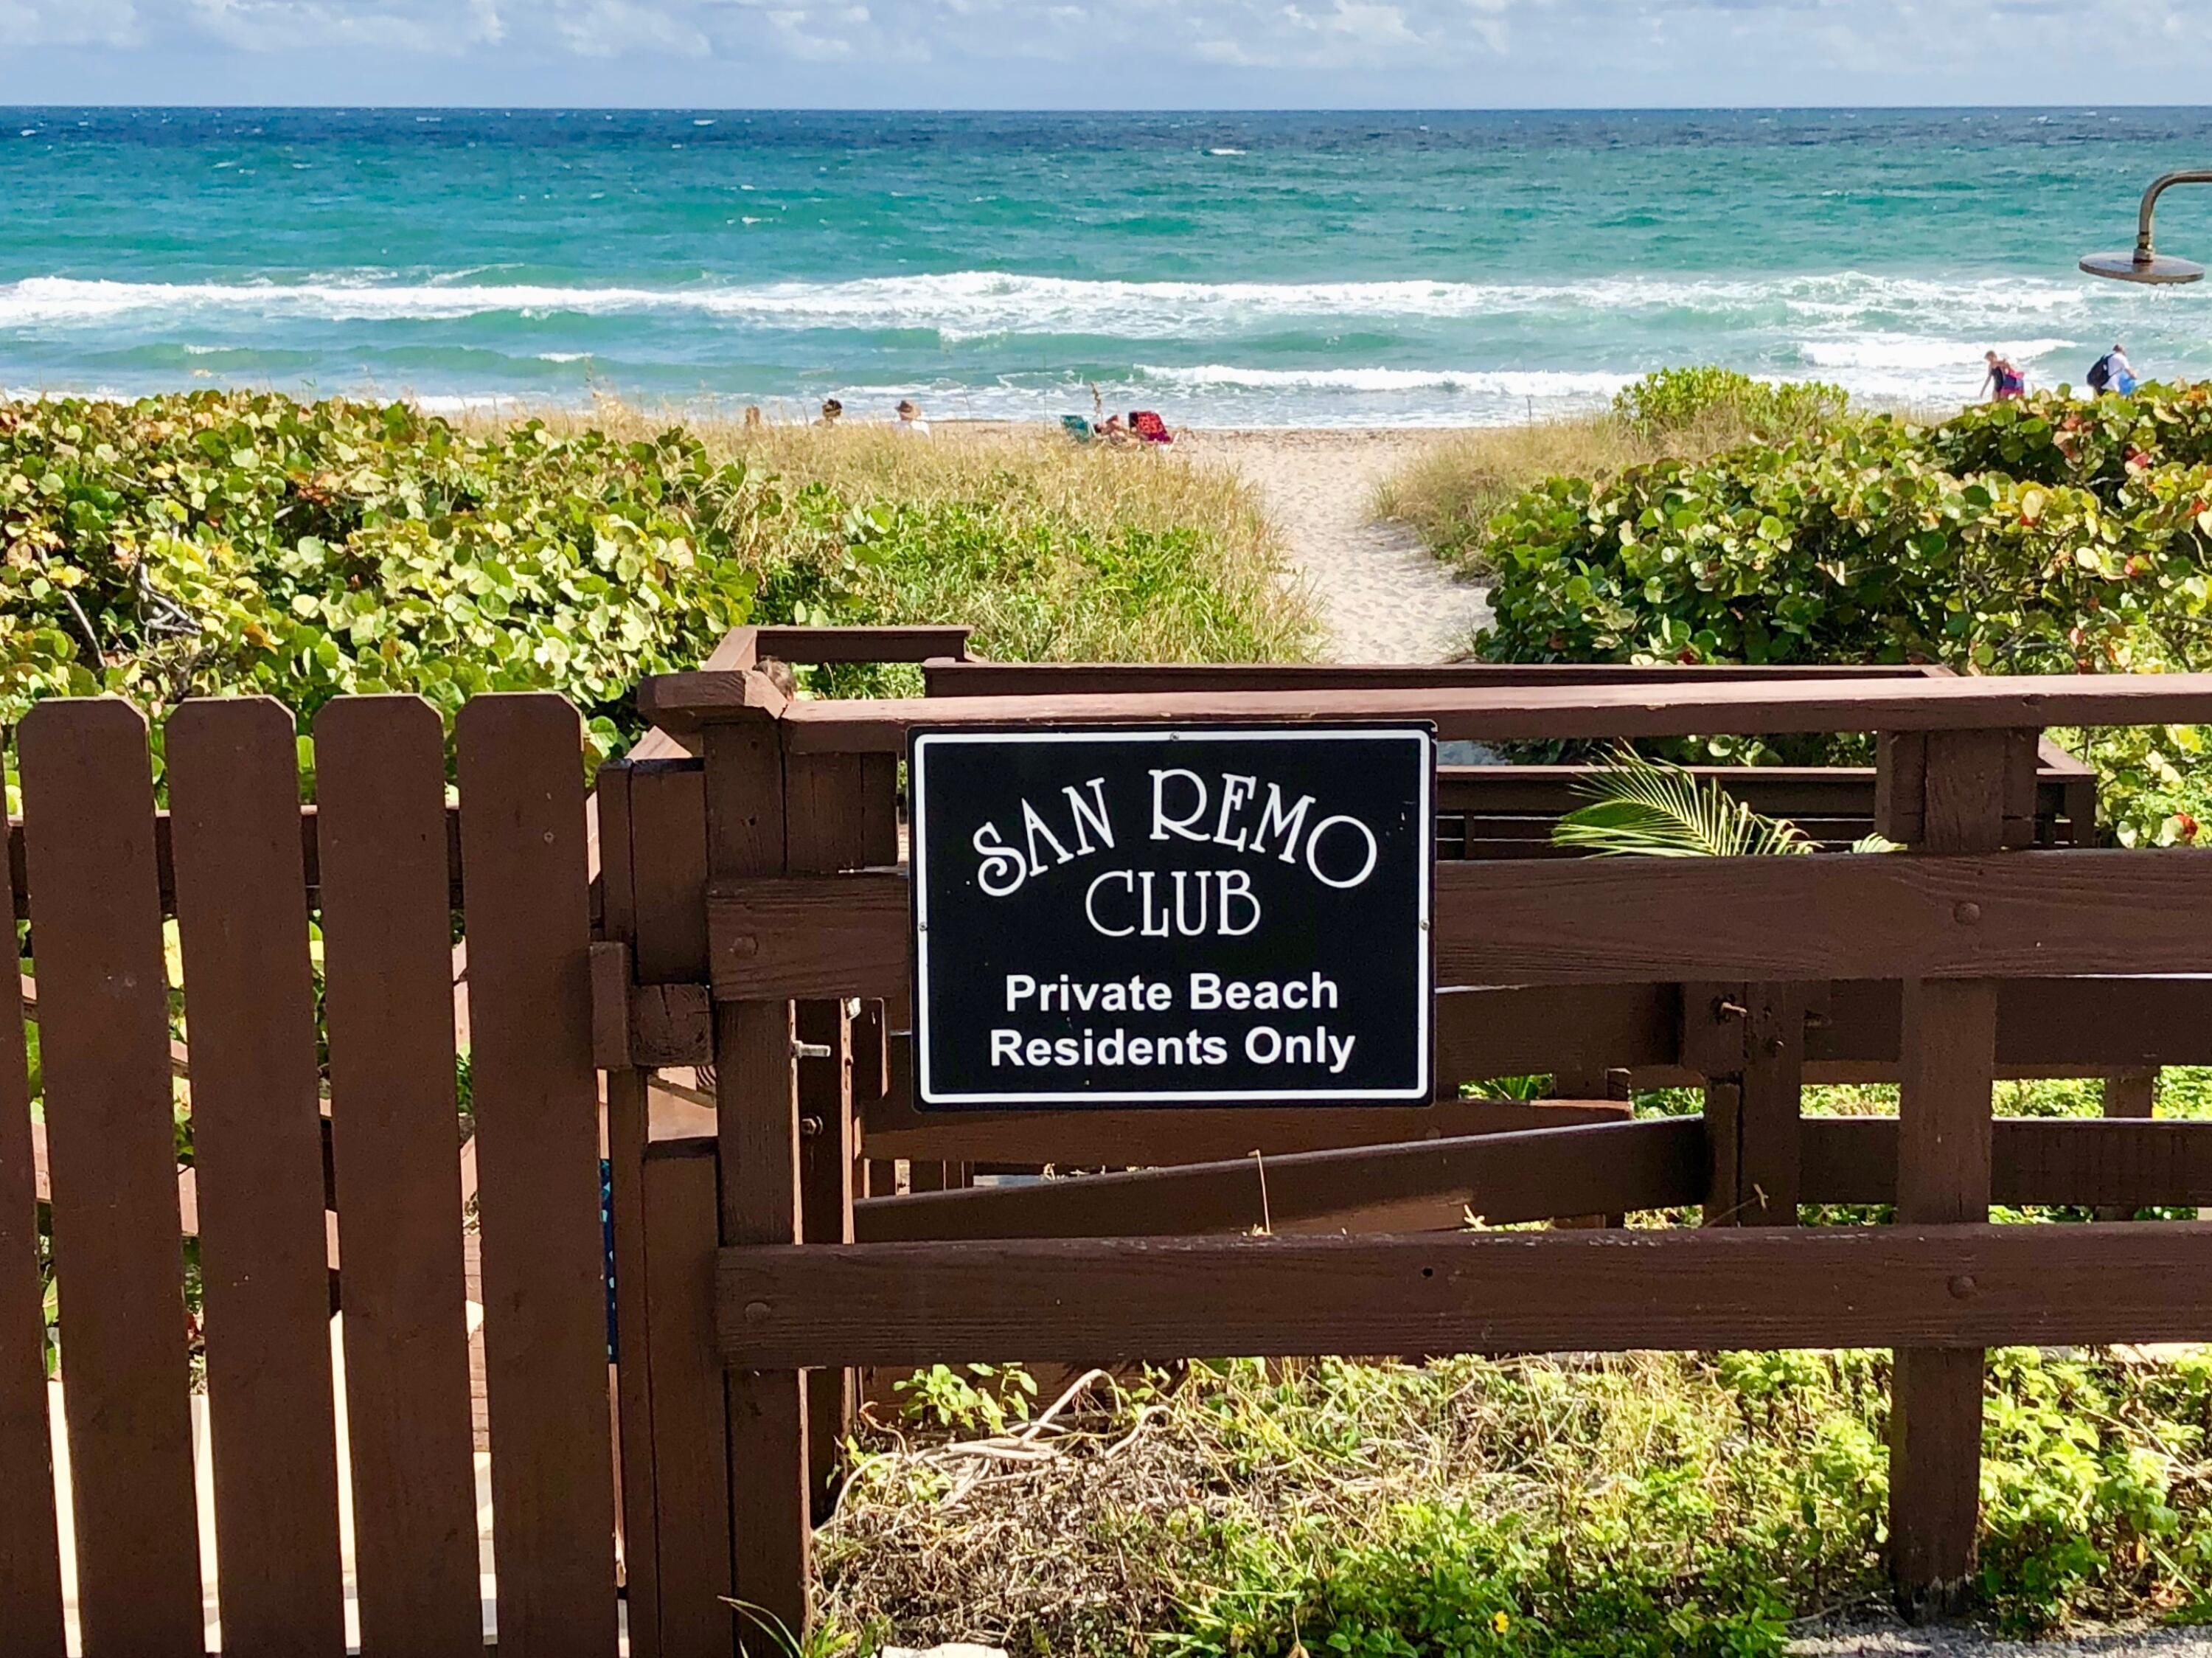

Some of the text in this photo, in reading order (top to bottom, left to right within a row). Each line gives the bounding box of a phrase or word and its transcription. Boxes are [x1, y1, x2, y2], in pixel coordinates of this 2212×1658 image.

[973, 769, 1377, 897] SAN REMO
[1085, 869, 1261, 937] CLUB
[1006, 971, 1338, 1012] Private Beach
[990, 1025, 1357, 1074] Residents Only
